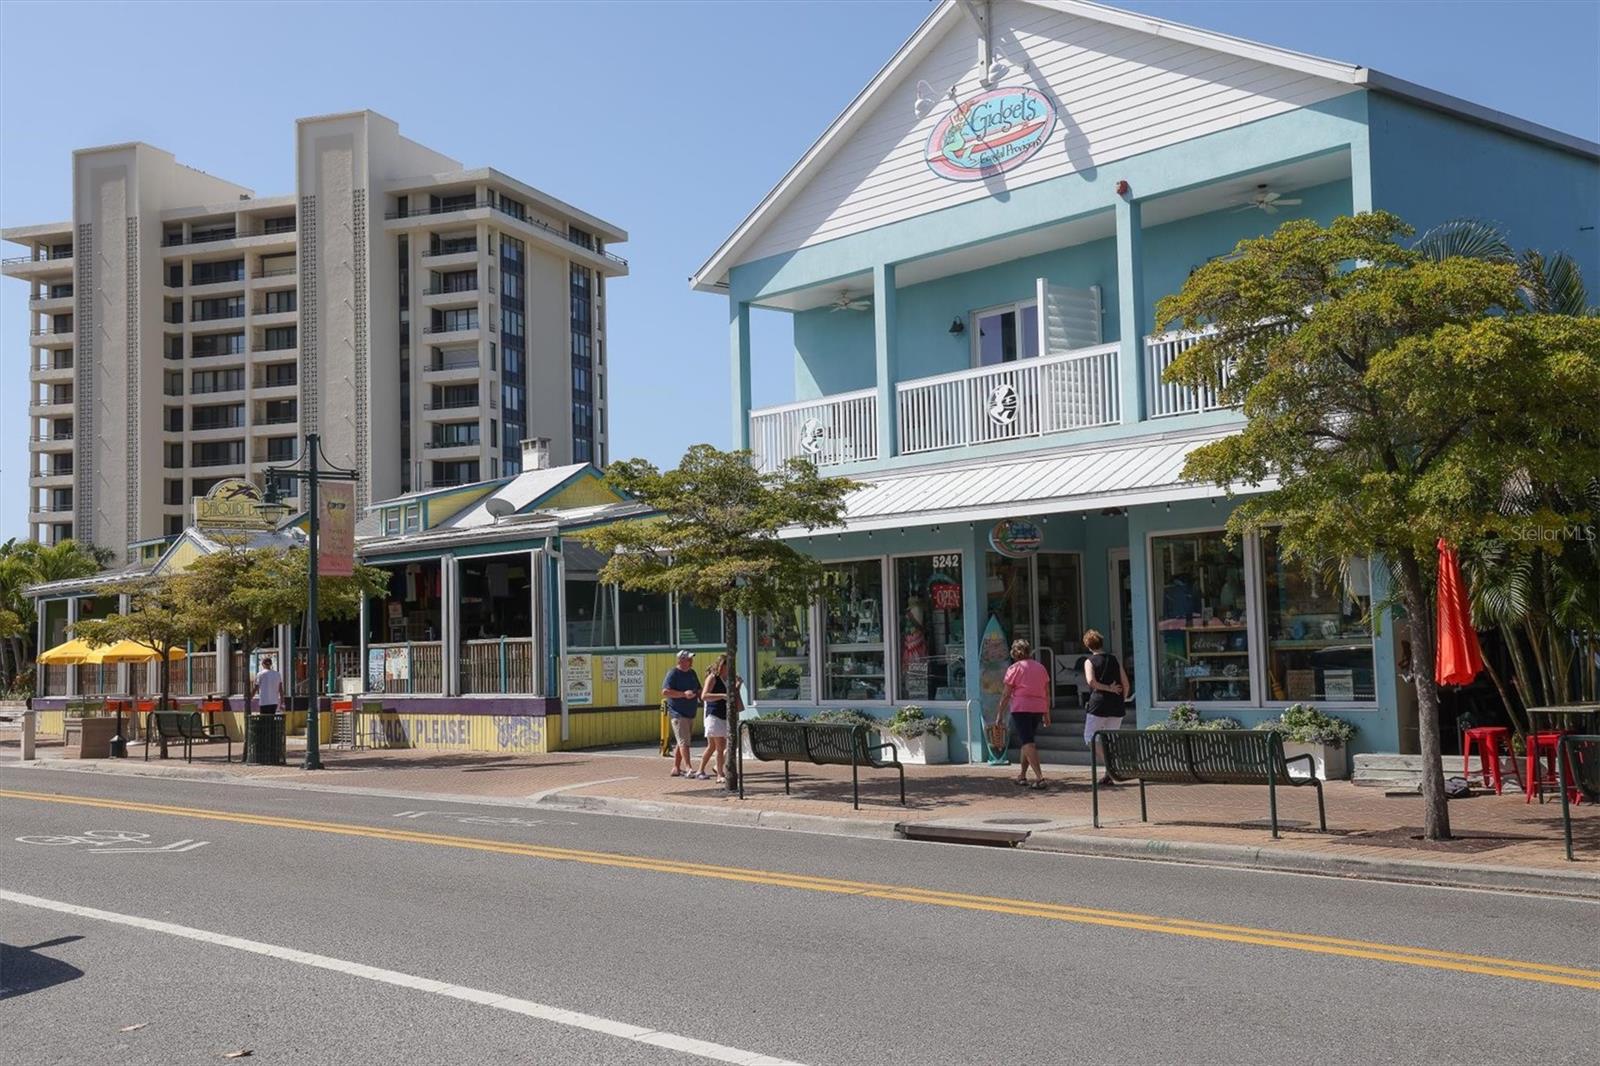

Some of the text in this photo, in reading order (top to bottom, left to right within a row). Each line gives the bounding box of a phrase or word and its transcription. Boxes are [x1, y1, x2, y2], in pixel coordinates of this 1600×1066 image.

[971, 93, 1037, 141] Gidgets
[932, 554, 959, 568] 5242
[936, 590, 960, 608] OPEN
[620, 676, 643, 685] PARKING
[415, 719, 471, 745] PLEASE!
